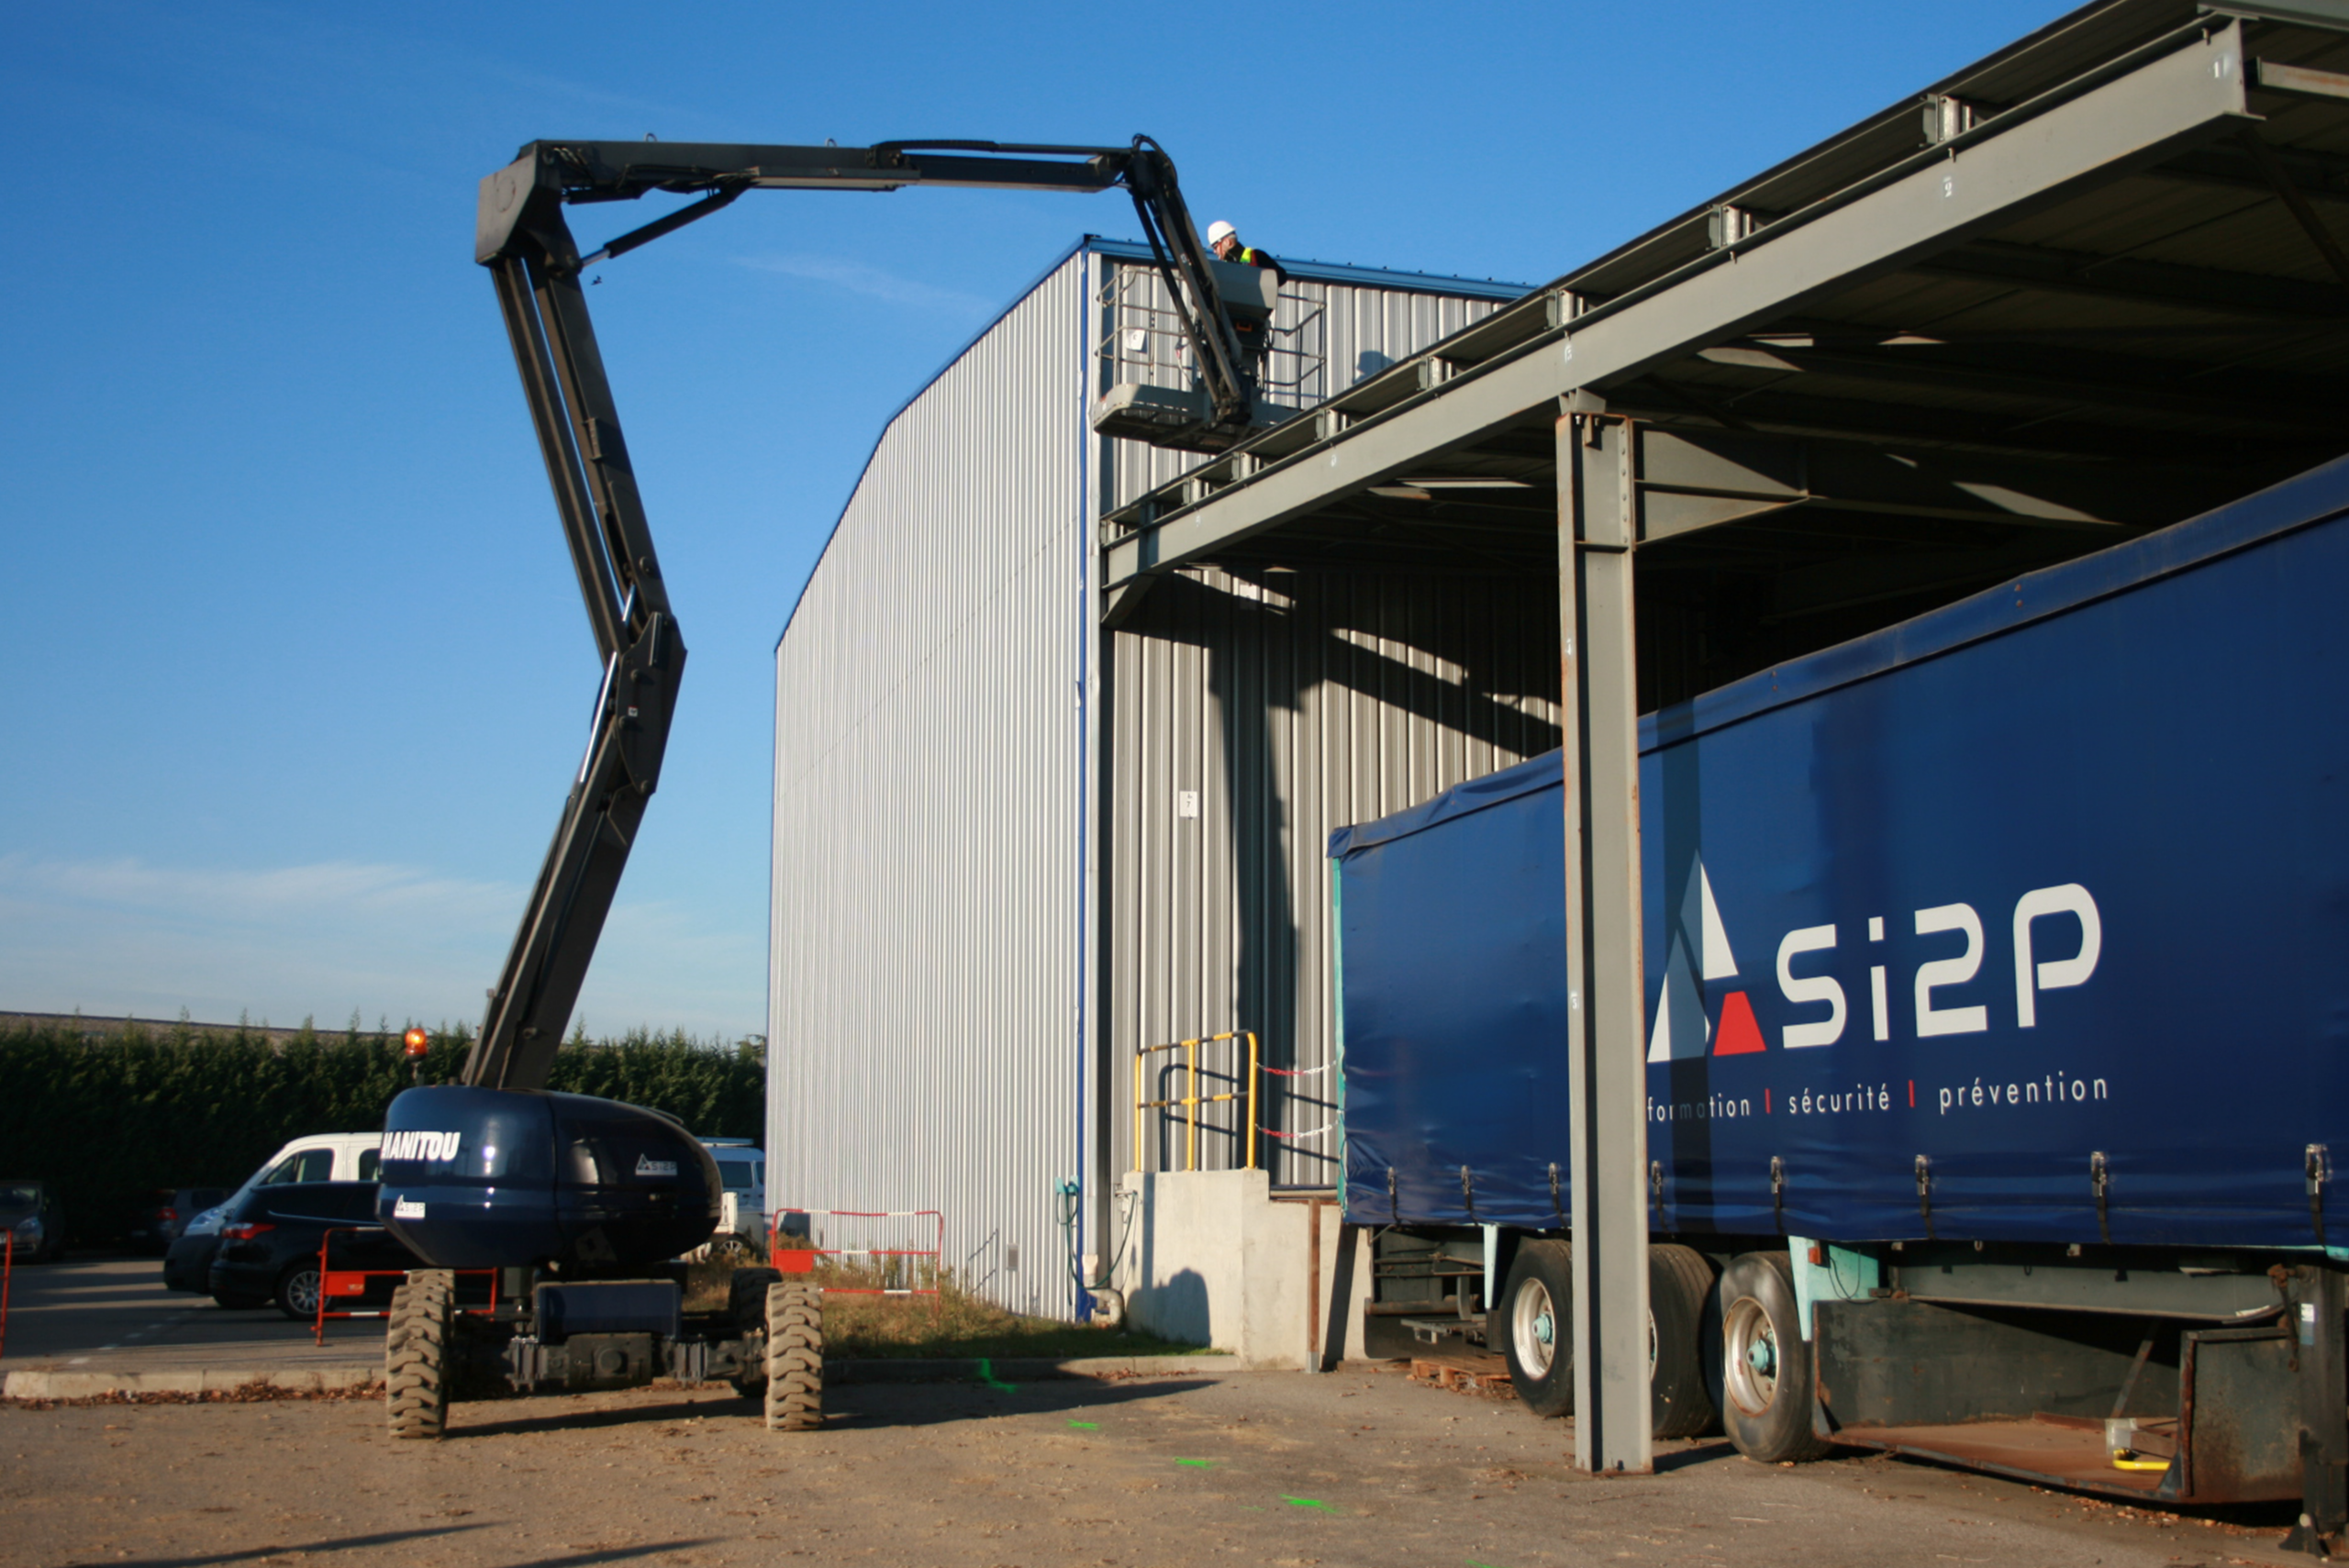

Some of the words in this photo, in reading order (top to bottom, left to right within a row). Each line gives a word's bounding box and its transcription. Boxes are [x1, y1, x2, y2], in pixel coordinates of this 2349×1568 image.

[1647, 1092, 1751, 1121] formation
[1787, 1083, 1890, 1114] sécurité
[1939, 1070, 2108, 1116] prévention
[380, 1130, 462, 1162] MANITOU
